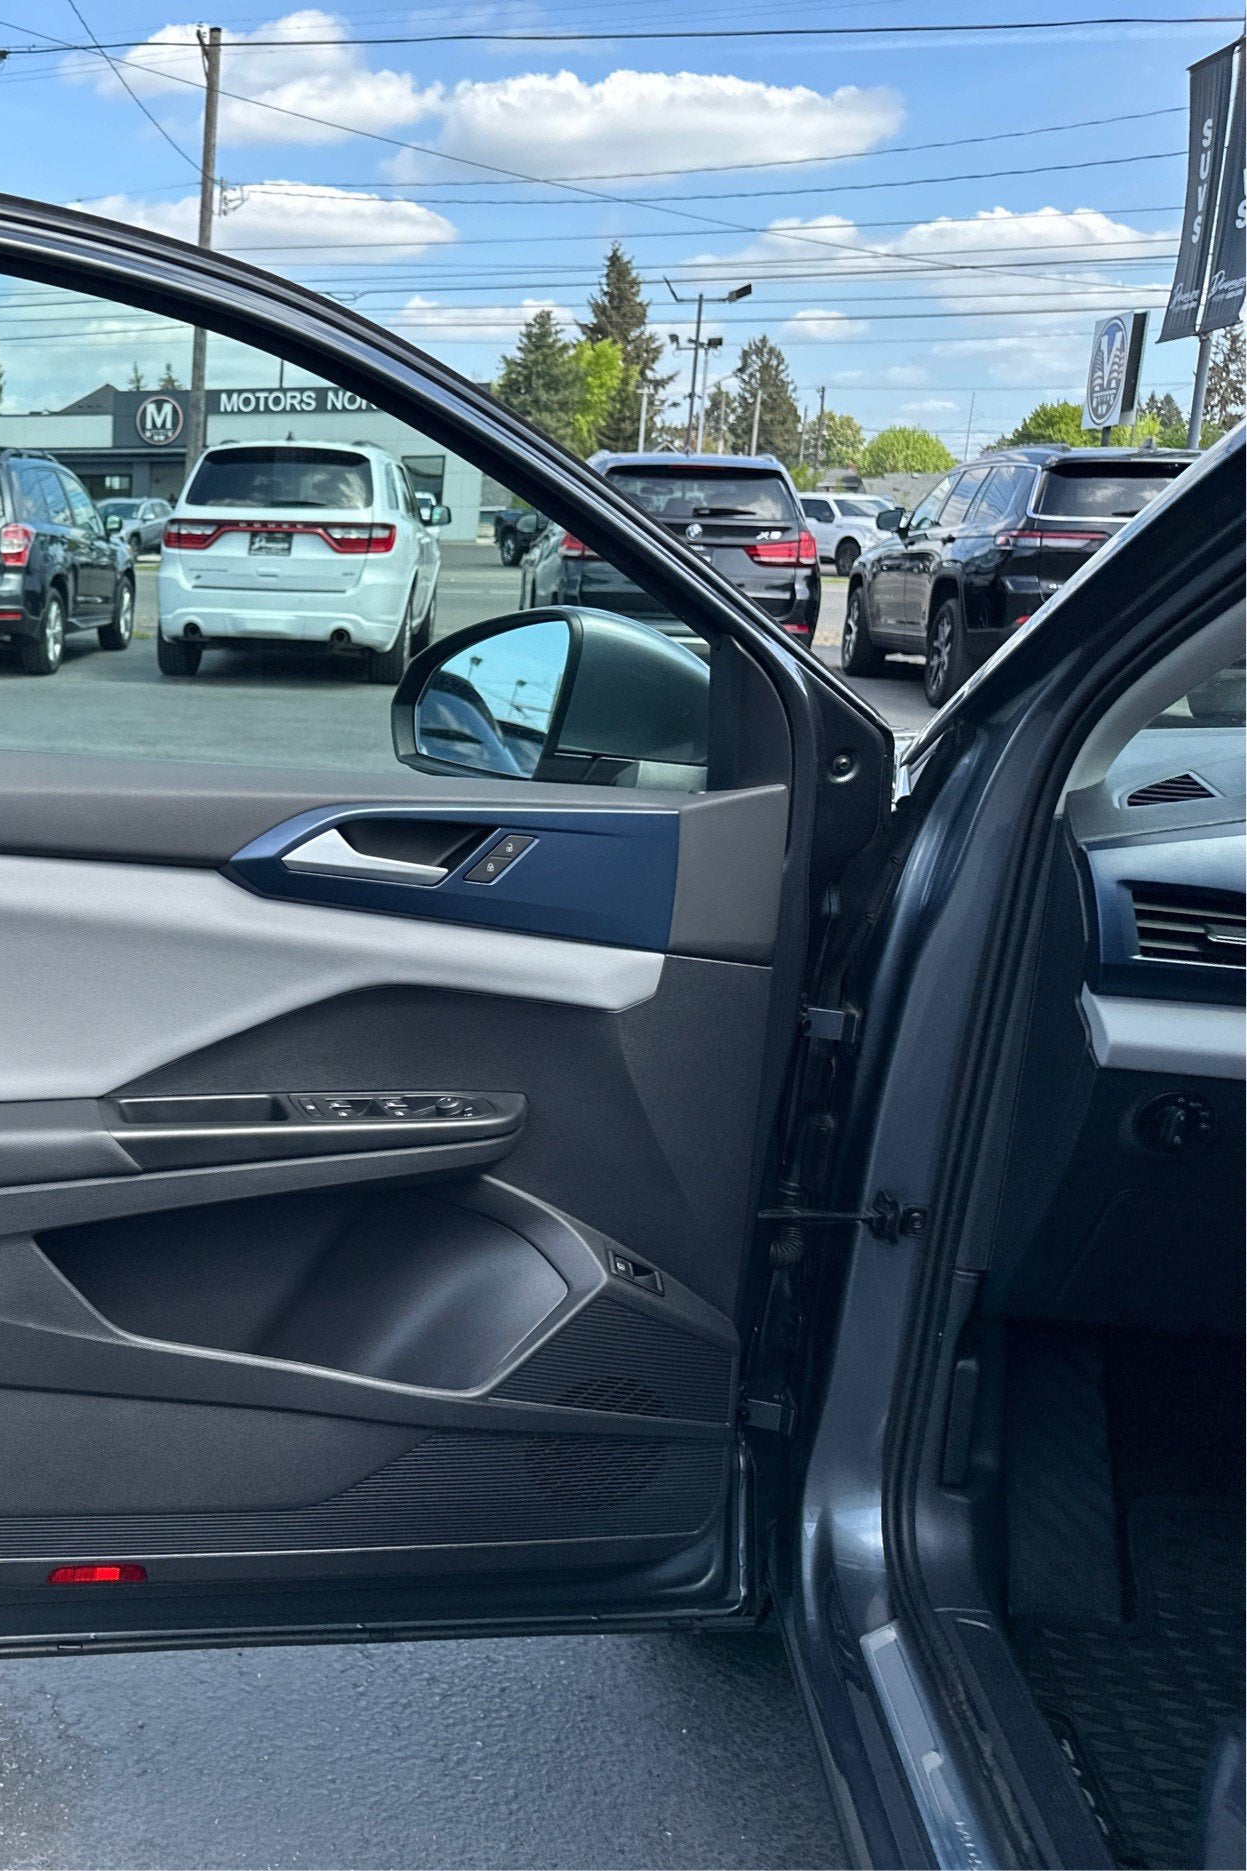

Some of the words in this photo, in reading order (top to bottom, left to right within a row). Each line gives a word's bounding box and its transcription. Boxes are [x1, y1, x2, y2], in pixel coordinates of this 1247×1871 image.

[1191, 118, 1213, 245] SUVS
[219, 390, 317, 412] MOTORS
[145, 402, 174, 430] M
